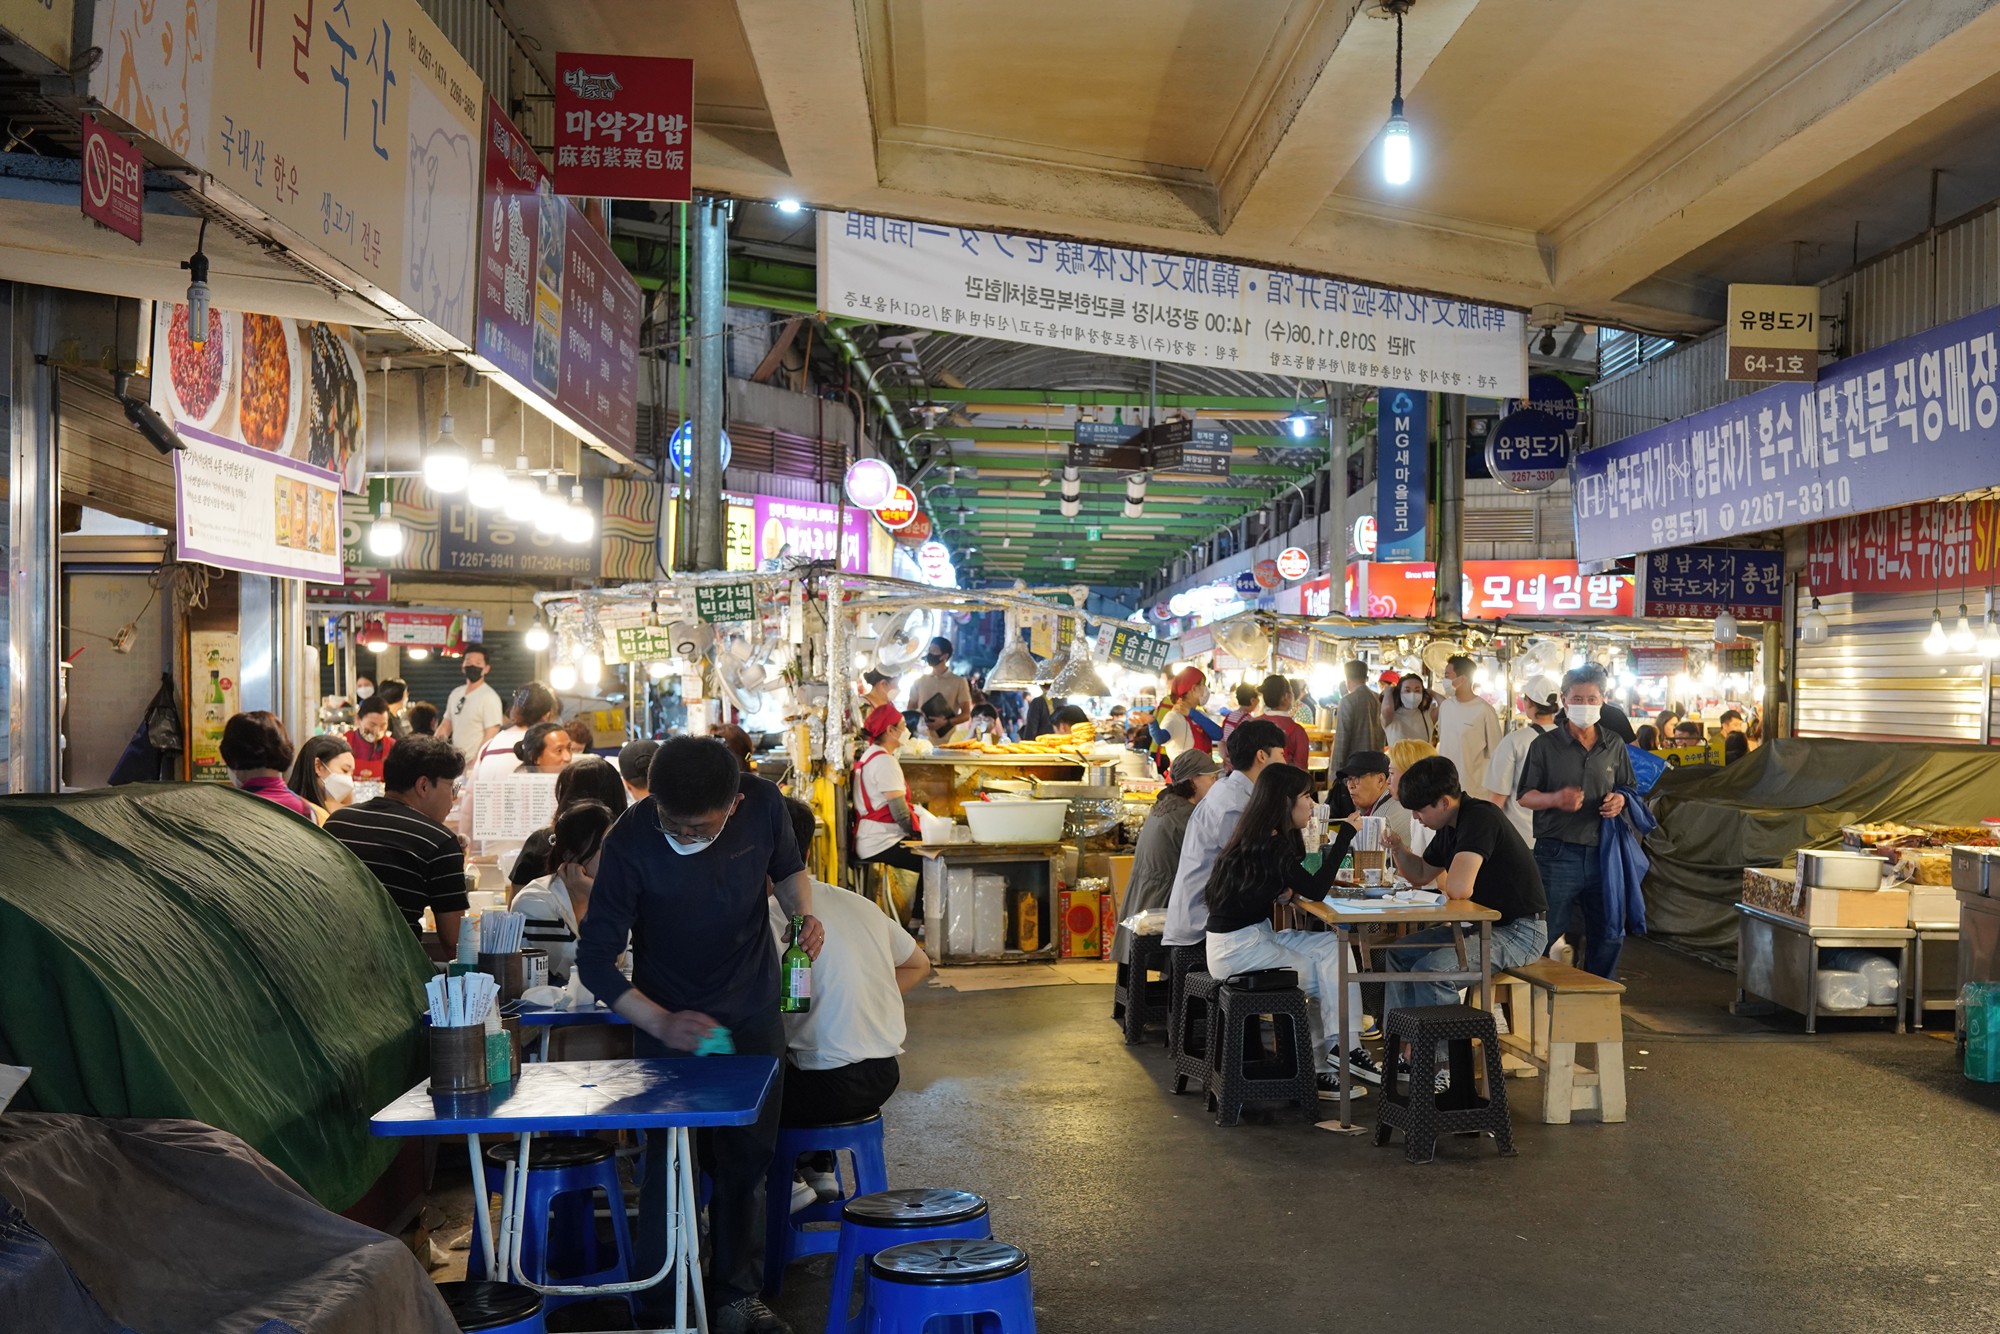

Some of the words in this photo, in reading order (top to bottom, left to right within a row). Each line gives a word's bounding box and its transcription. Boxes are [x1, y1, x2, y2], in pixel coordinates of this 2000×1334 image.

[408, 28, 416, 56] Tel
[418, 40, 447, 92] 2267-1474
[565, 109, 688, 145] 마약김밥
[558, 145, 685, 171] 麻药紫菜包饭
[111, 152, 139, 202] 금연
[220, 115, 265, 187] 국내산
[274, 154, 299, 204] 한우
[320, 192, 354, 246] 생고기
[361, 221, 381, 269] 전문
[1739, 311, 1813, 332] 유명도기
[1744, 355, 1804, 373] 64-1호
[1607, 443, 1666, 519] 한국도자기
[1692, 415, 1751, 498] 행남자기
[1844, 368, 1888, 458] 전문
[1894, 332, 1998, 443] 직영매장
[1497, 434, 1564, 460] 유명도기
[1394, 416, 1414, 532] MG새마을금고
[1512, 471, 1555, 482] 2267-3310
[1651, 508, 1708, 544] 유명도기
[1740, 476, 1850, 527] 2267-3310
[520, 555, 591, 571] 017-204-4816
[1652, 553, 1735, 576] 행남자기
[1652, 576, 1735, 599] 한국도자기
[1741, 562, 1780, 595] 총판
[699, 585, 751, 600] 박가네
[1481, 573, 1624, 611] 모녀김밥
[700, 599, 752, 614] 빈대떡
[713, 612, 752, 622] 2264-0847
[1751, 606, 1773, 618] 도매
[621, 638, 669, 654] 빈대떡
[1111, 632, 1127, 657] 원조
[1127, 635, 1168, 656] 순희네
[1124, 649, 1164, 670] 빈대떡
